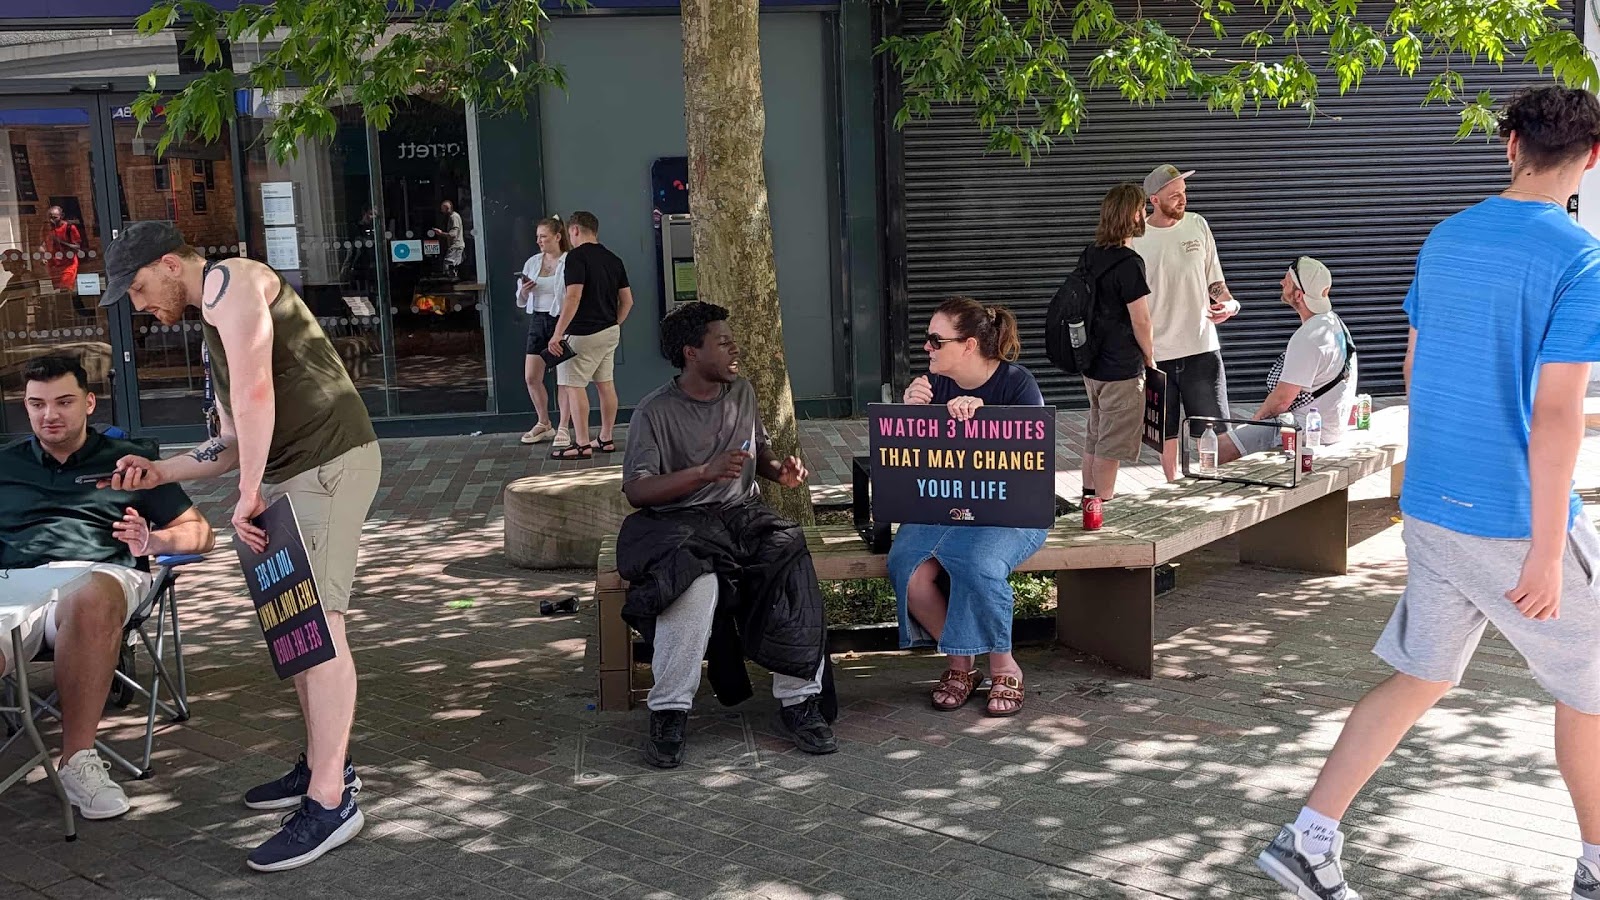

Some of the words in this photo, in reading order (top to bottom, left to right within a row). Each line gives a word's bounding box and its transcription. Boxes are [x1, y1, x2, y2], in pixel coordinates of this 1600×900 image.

[879, 418, 939, 438] WATCH
[947, 419, 957, 438] 3
[965, 420, 1045, 440] MINUTES
[879, 448, 921, 467] THAT
[928, 449, 966, 469] MAY
[973, 450, 1045, 470] CHANGE
[917, 479, 963, 498] YOUR
[971, 481, 1007, 500] LIFE
[255, 563, 270, 592] SEE
[267, 556, 280, 584] TO
[275, 547, 295, 579] YOU
[274, 588, 298, 623] DON'T
[295, 578, 317, 611] THEY
[258, 601, 279, 632] WANT
[273, 633, 296, 664] VIDEO
[291, 627, 309, 656] THE
[304, 620, 322, 650] SEE
[1310, 823, 1327, 833] LIFE
